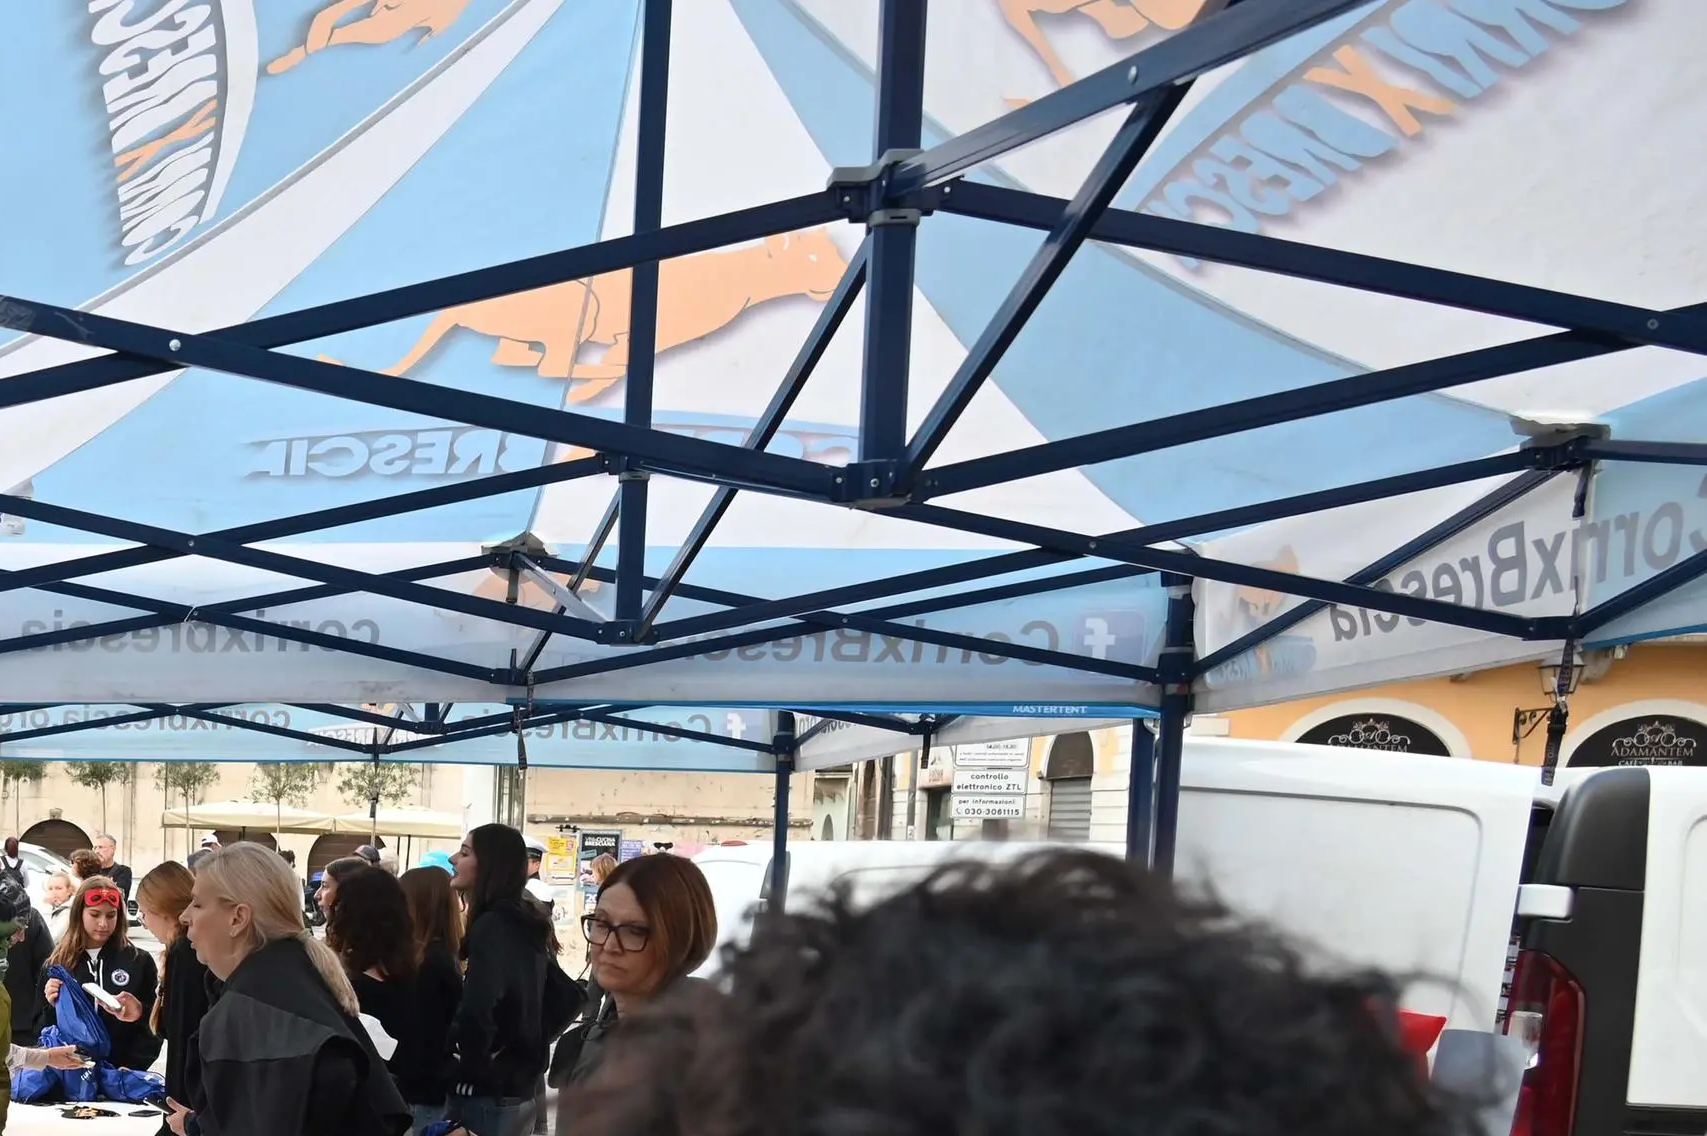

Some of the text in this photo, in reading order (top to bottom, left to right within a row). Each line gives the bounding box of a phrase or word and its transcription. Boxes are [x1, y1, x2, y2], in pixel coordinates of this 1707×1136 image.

[1012, 705, 1088, 714] MASTERTENT
[1610, 747, 1694, 756] ADAMANTEM
[970, 772, 1009, 781] controllo
[956, 783, 1022, 791] elettronico ZTL
[964, 808, 1020, 816] 030-3061115
